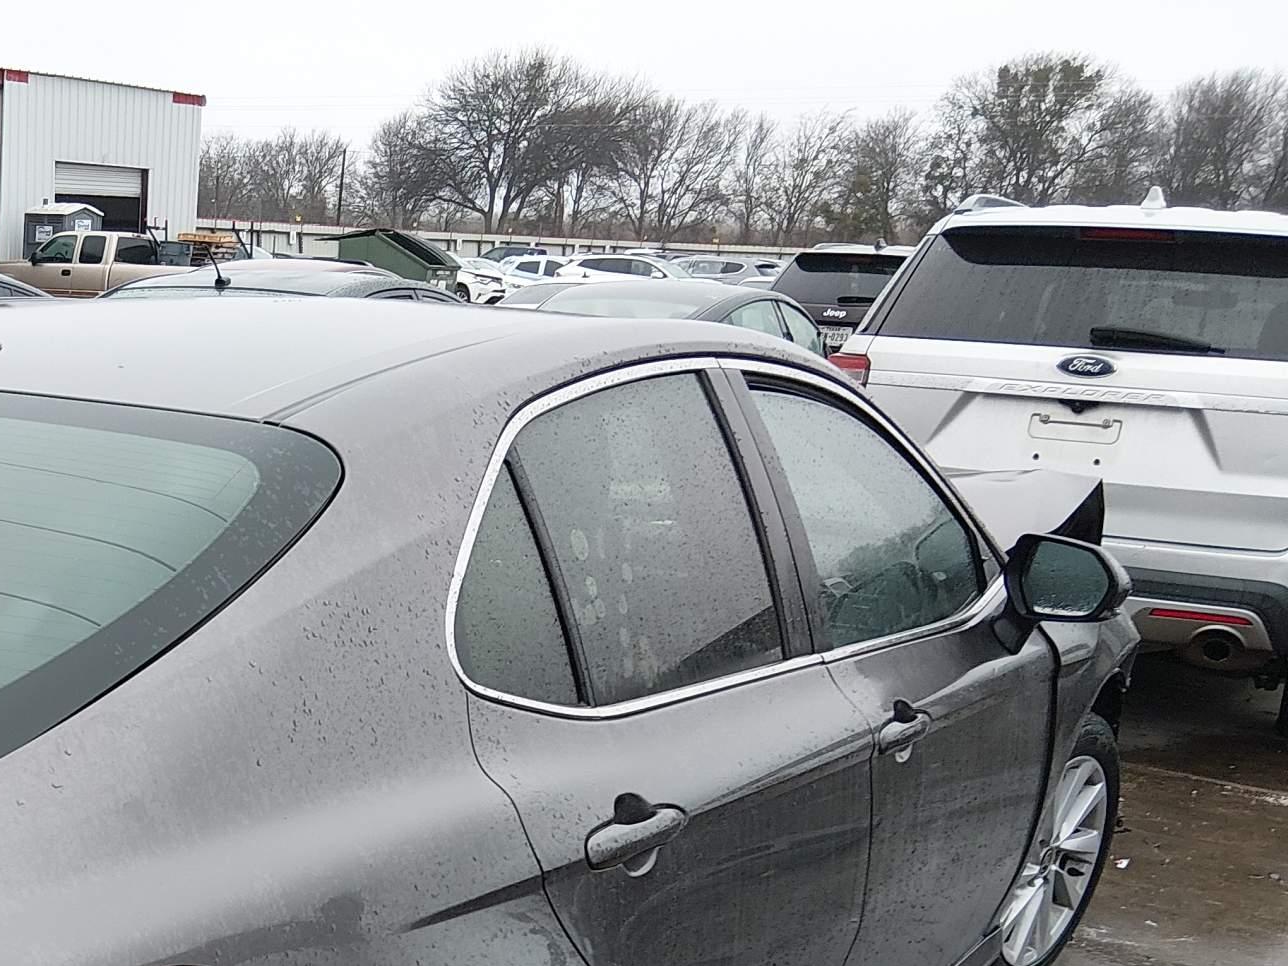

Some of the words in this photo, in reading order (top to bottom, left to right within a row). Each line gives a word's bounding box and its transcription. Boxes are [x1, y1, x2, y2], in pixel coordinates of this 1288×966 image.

[823, 308, 847, 319] Jeep
[1068, 357, 1104, 374] Ford
[998, 383, 1168, 402] EXPLORER
